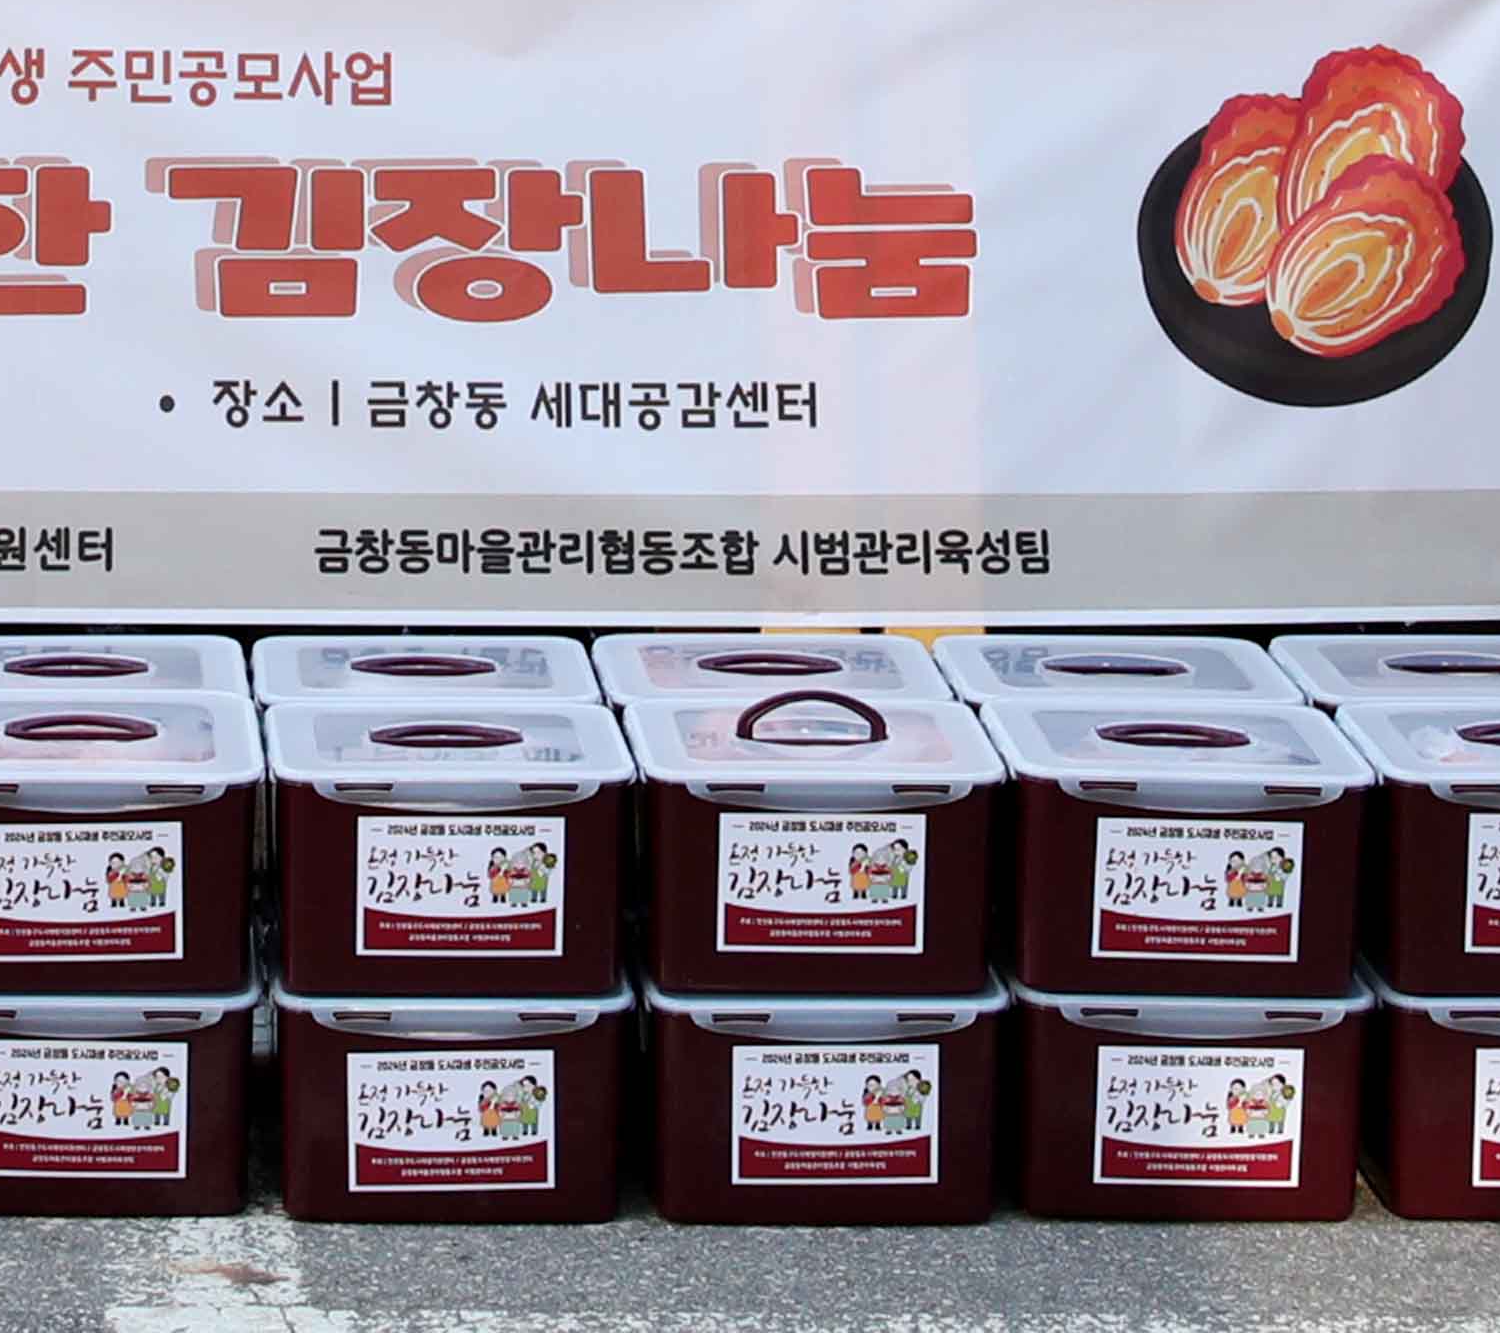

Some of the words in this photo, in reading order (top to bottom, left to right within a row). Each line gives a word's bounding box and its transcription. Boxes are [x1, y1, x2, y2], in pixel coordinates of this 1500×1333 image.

[70, 49, 393, 107] 주민공모사업
[150, 158, 978, 323] 김장나눔
[213, 380, 304, 428] 장소
[367, 380, 508, 430] 금창동
[531, 382, 818, 431] 세대공감센터
[314, 527, 760, 577] 금창동마을관리협동조합
[772, 529, 1051, 577] 시범관리육성팀
[367, 871, 481, 909] 김장나눔
[728, 867, 842, 905] 김장나눔
[1104, 873, 1218, 911] 김장나눔
[358, 1105, 472, 1145] 김장나눔
[742, 1099, 856, 1138] 김장나눔
[1106, 1101, 1220, 1138] 김장나눔
